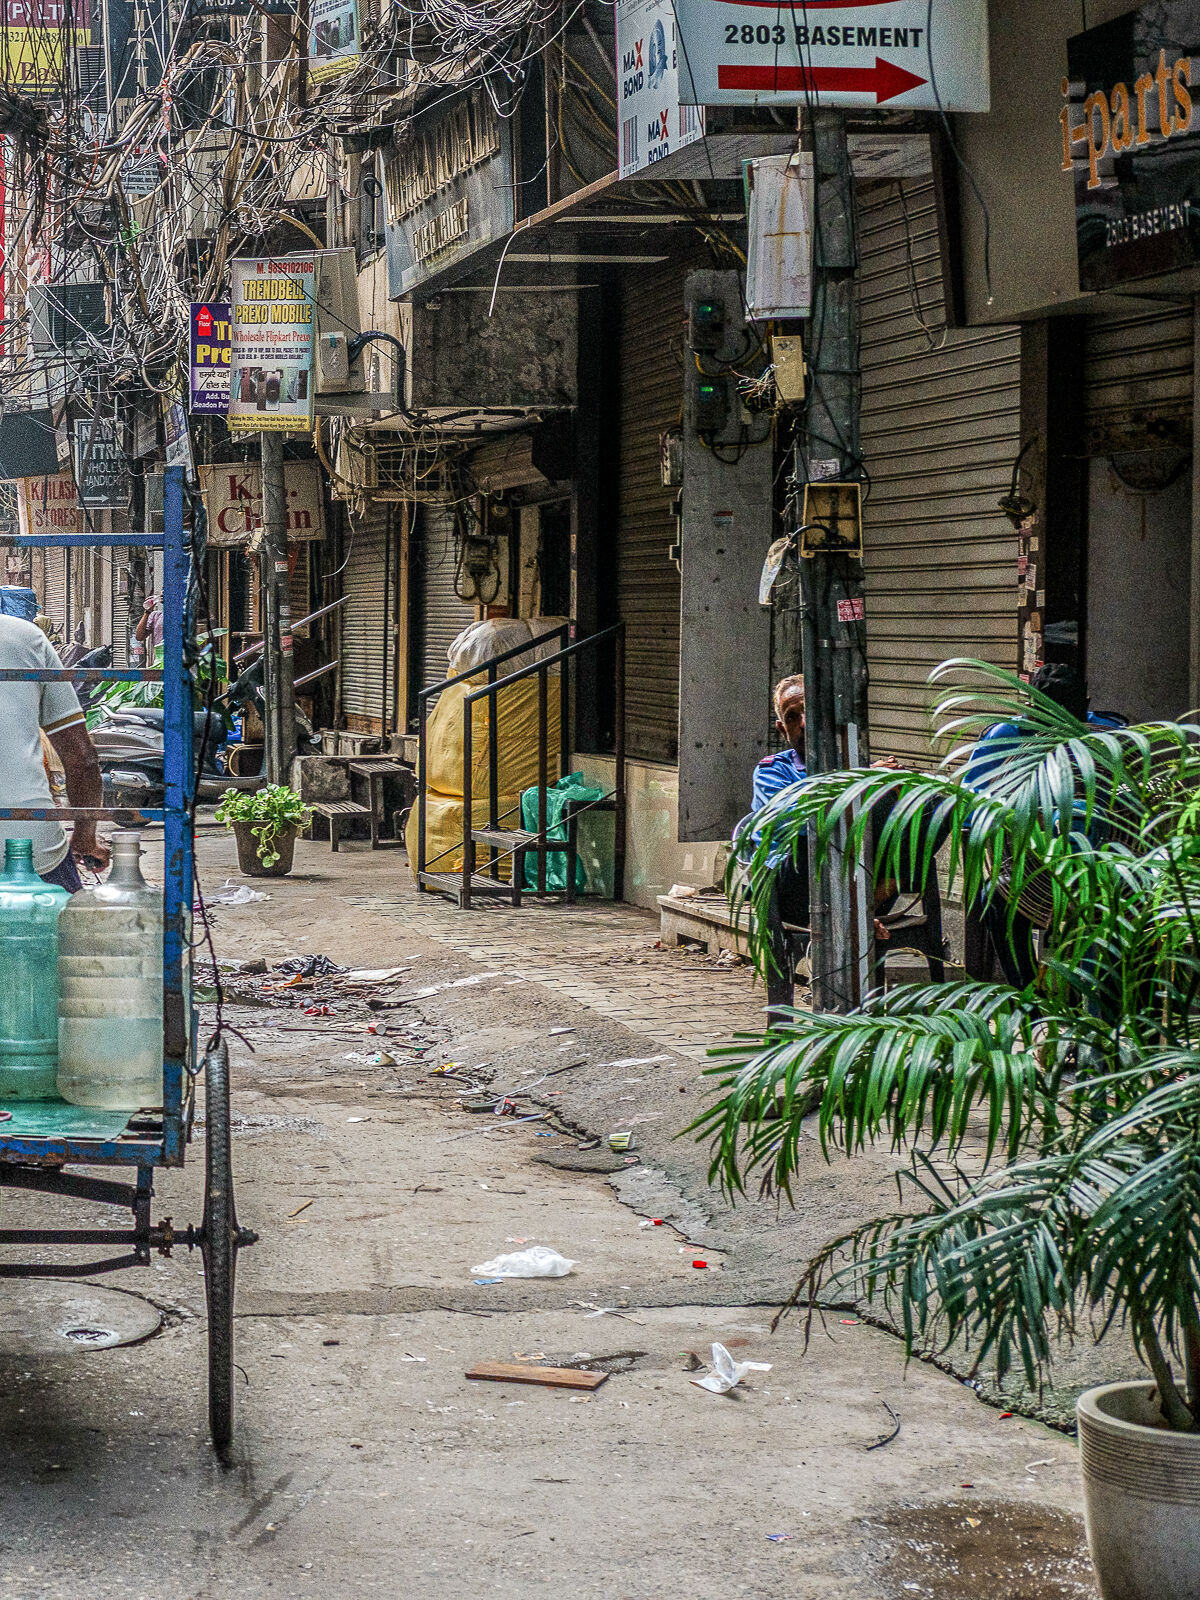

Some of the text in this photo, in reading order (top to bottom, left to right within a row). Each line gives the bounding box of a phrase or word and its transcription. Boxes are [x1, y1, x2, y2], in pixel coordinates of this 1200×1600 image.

[724, 24, 923, 48] 2803 BASEMENT
[623, 38, 644, 74] MAX
[623, 71, 644, 100] BOND
[647, 108, 669, 143] MAX
[1059, 47, 1193, 190] i-parts
[1132, 199, 1191, 240] BASEMENT
[243, 279, 306, 301] TRENDBELL
[235, 304, 313, 324] PREXO MOBILE
[232, 330, 265, 342] Wholesale
[265, 330, 292, 345] Flipkart
[35, 507, 78, 527] STORES
[217, 505, 312, 534] Chin
